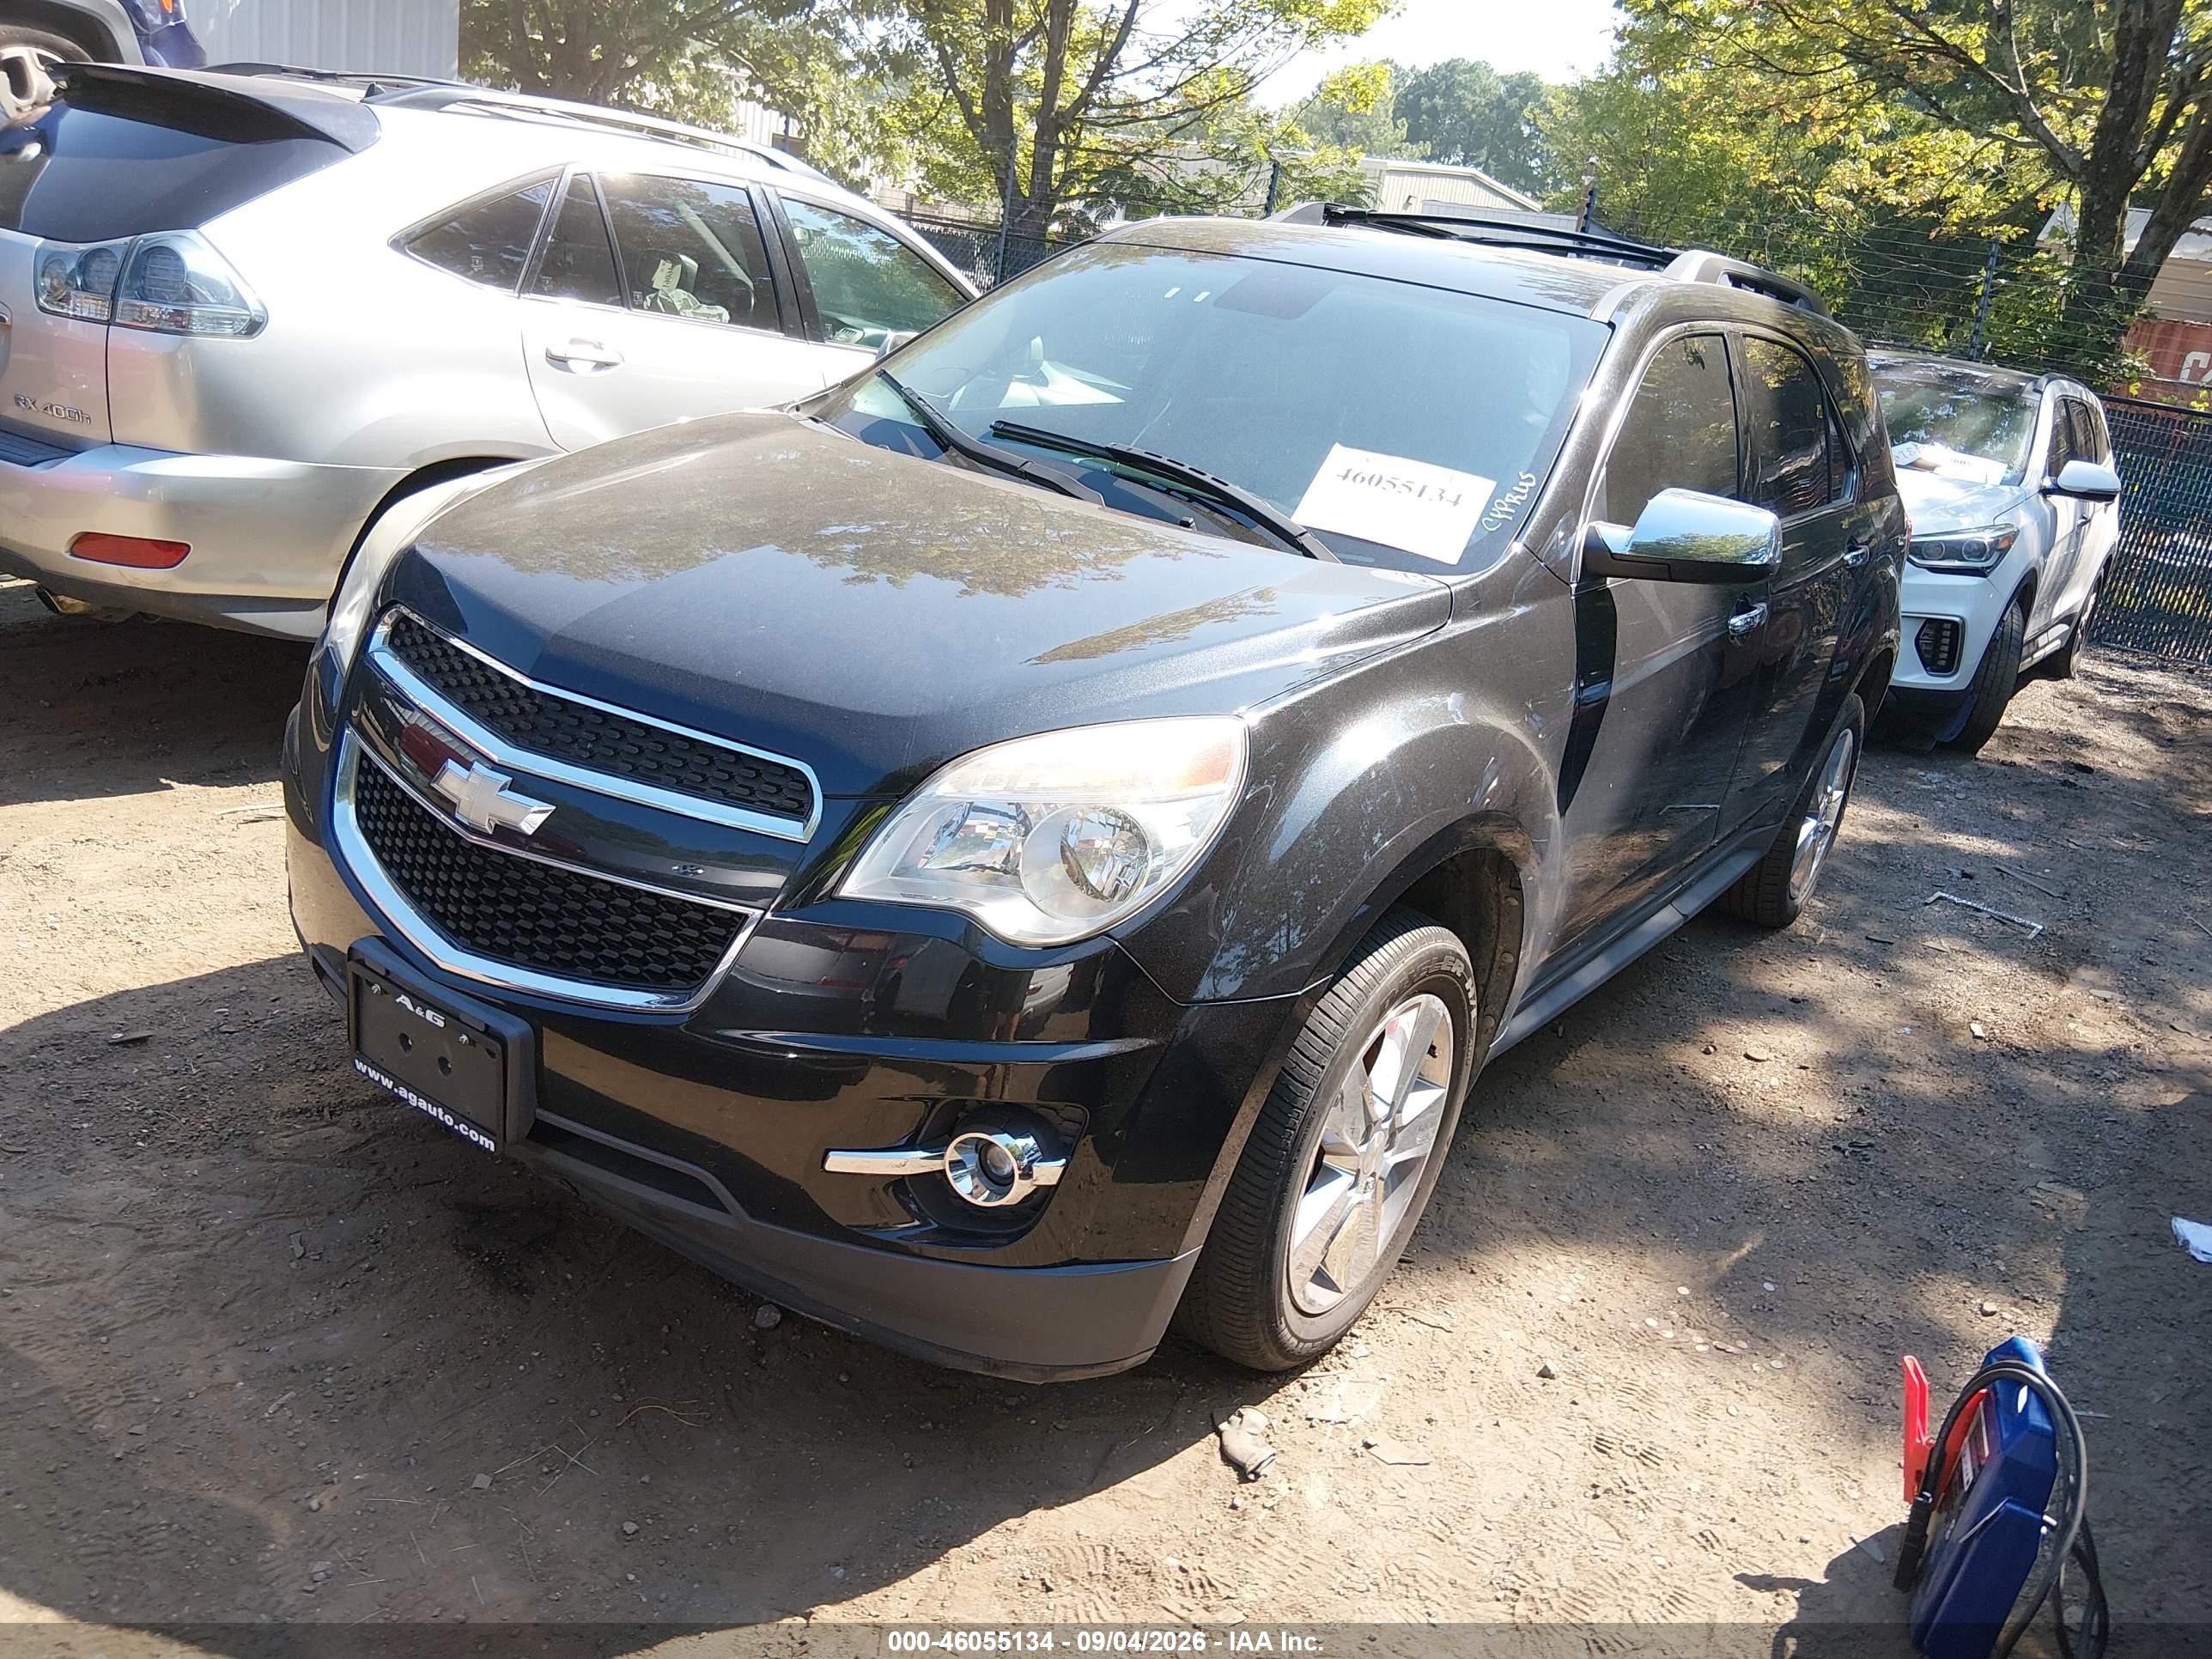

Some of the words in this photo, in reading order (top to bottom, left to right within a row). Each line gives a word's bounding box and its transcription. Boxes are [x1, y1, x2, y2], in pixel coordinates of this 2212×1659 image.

[14, 393, 40, 412] RX
[41, 402, 92, 424] 400h
[1336, 468, 1462, 507] 46055134
[395, 994, 446, 1028] A&G
[354, 1058, 495, 1152] www.agauto.com
